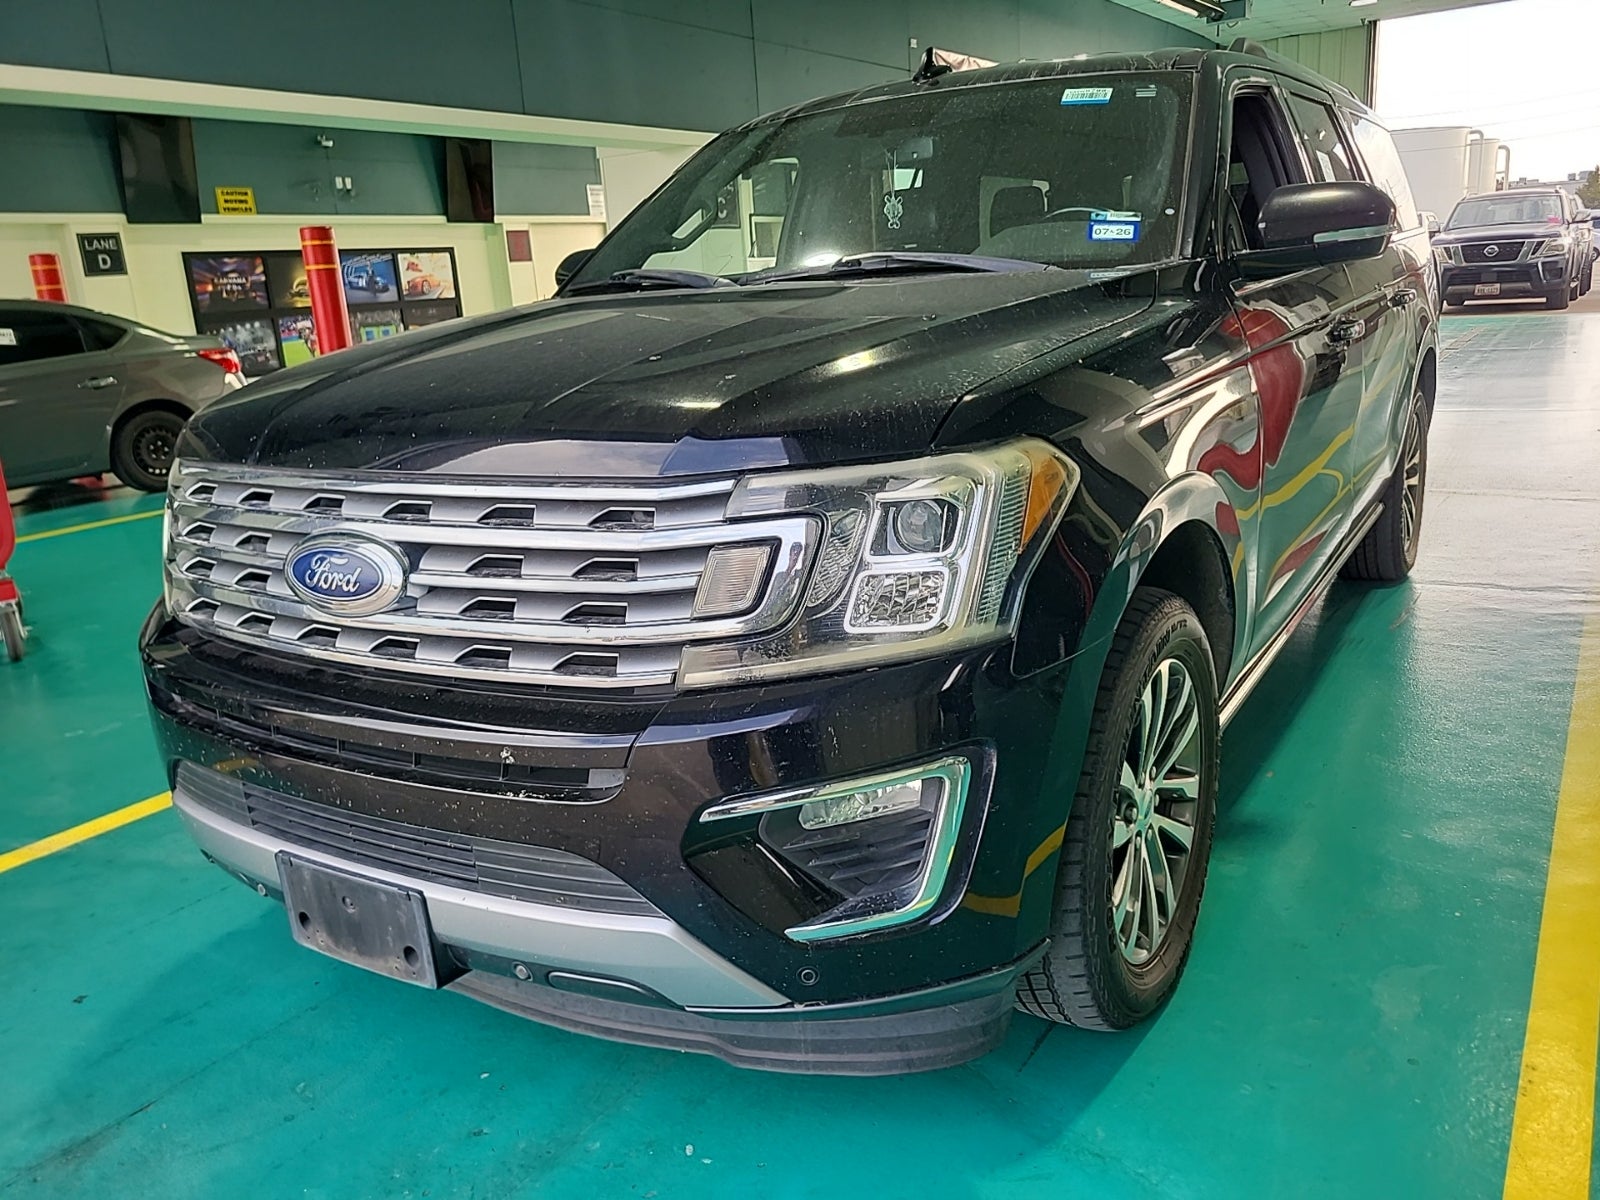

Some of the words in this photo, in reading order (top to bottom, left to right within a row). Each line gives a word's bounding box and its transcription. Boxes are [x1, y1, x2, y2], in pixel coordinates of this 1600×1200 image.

[84, 238, 118, 250] LANE
[97, 253, 112, 269] D
[305, 554, 362, 593] Ford
